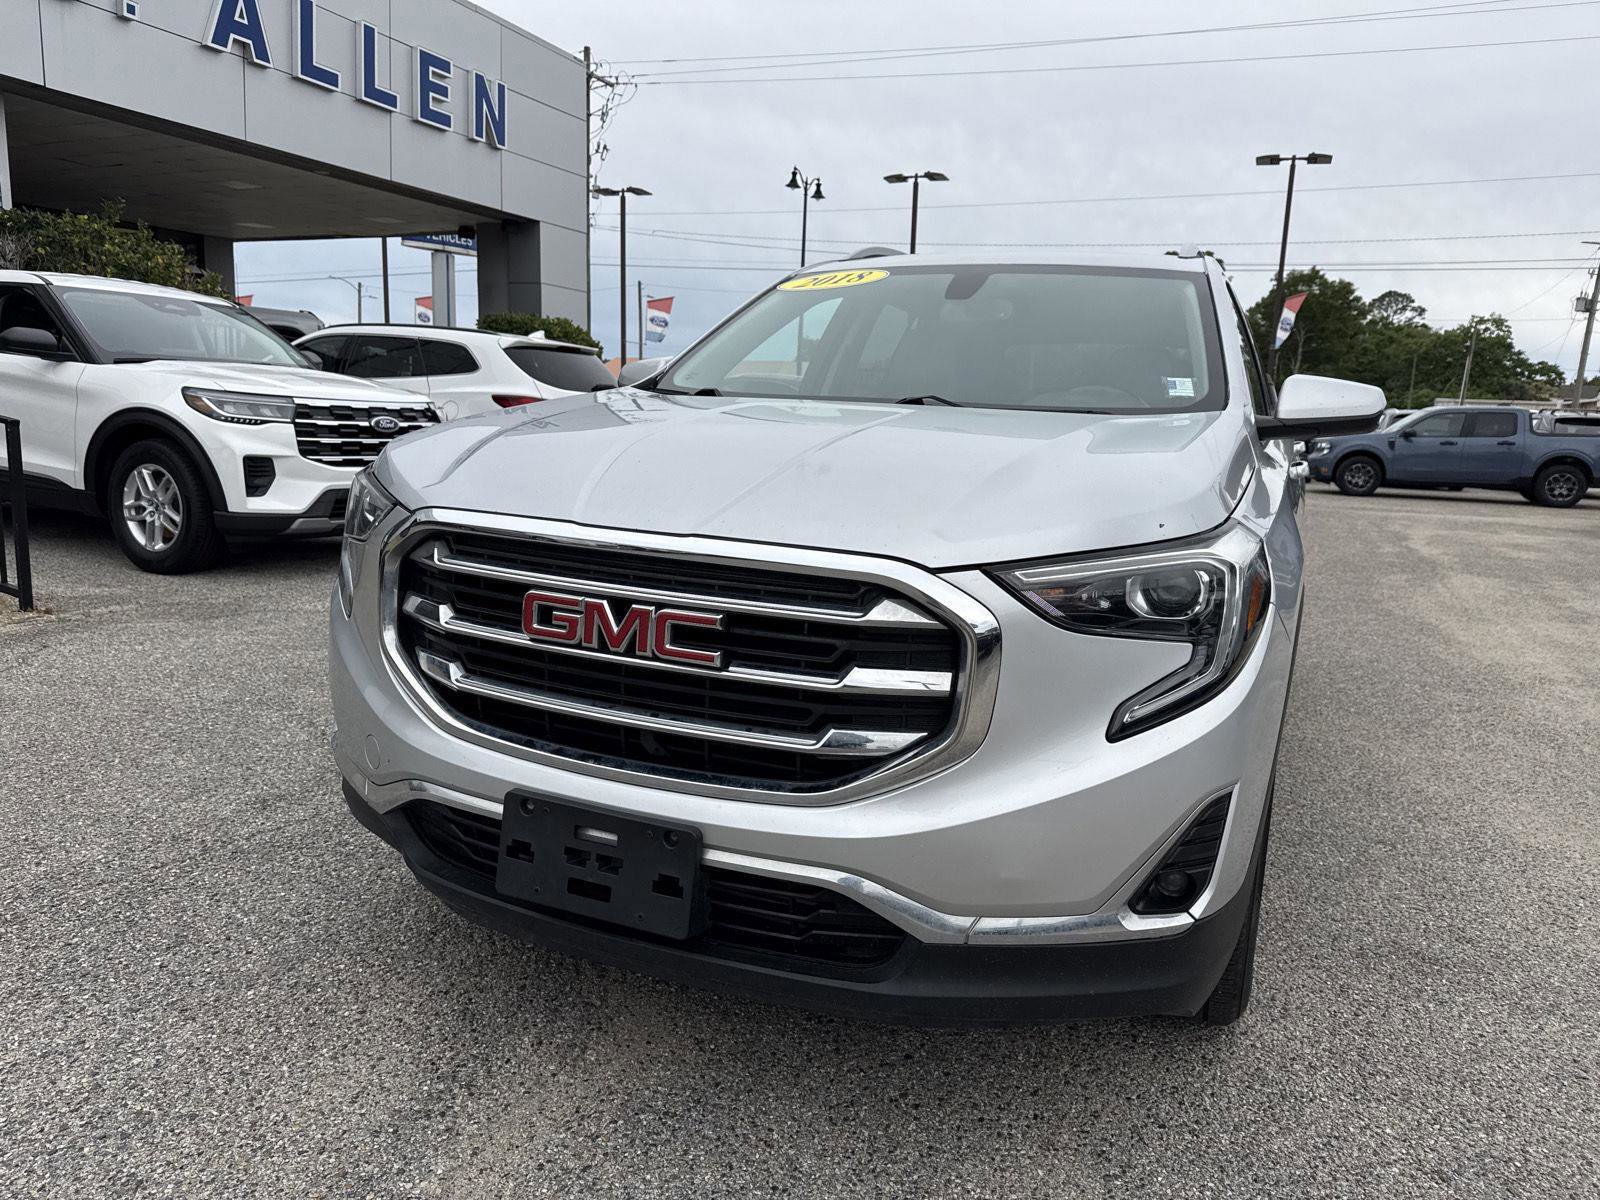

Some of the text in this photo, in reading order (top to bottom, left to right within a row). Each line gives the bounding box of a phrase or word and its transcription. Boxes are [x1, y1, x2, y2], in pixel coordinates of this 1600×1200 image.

[203, 0, 507, 149] ALLEN
[791, 271, 875, 289] 2018
[522, 589, 724, 668] GMC
